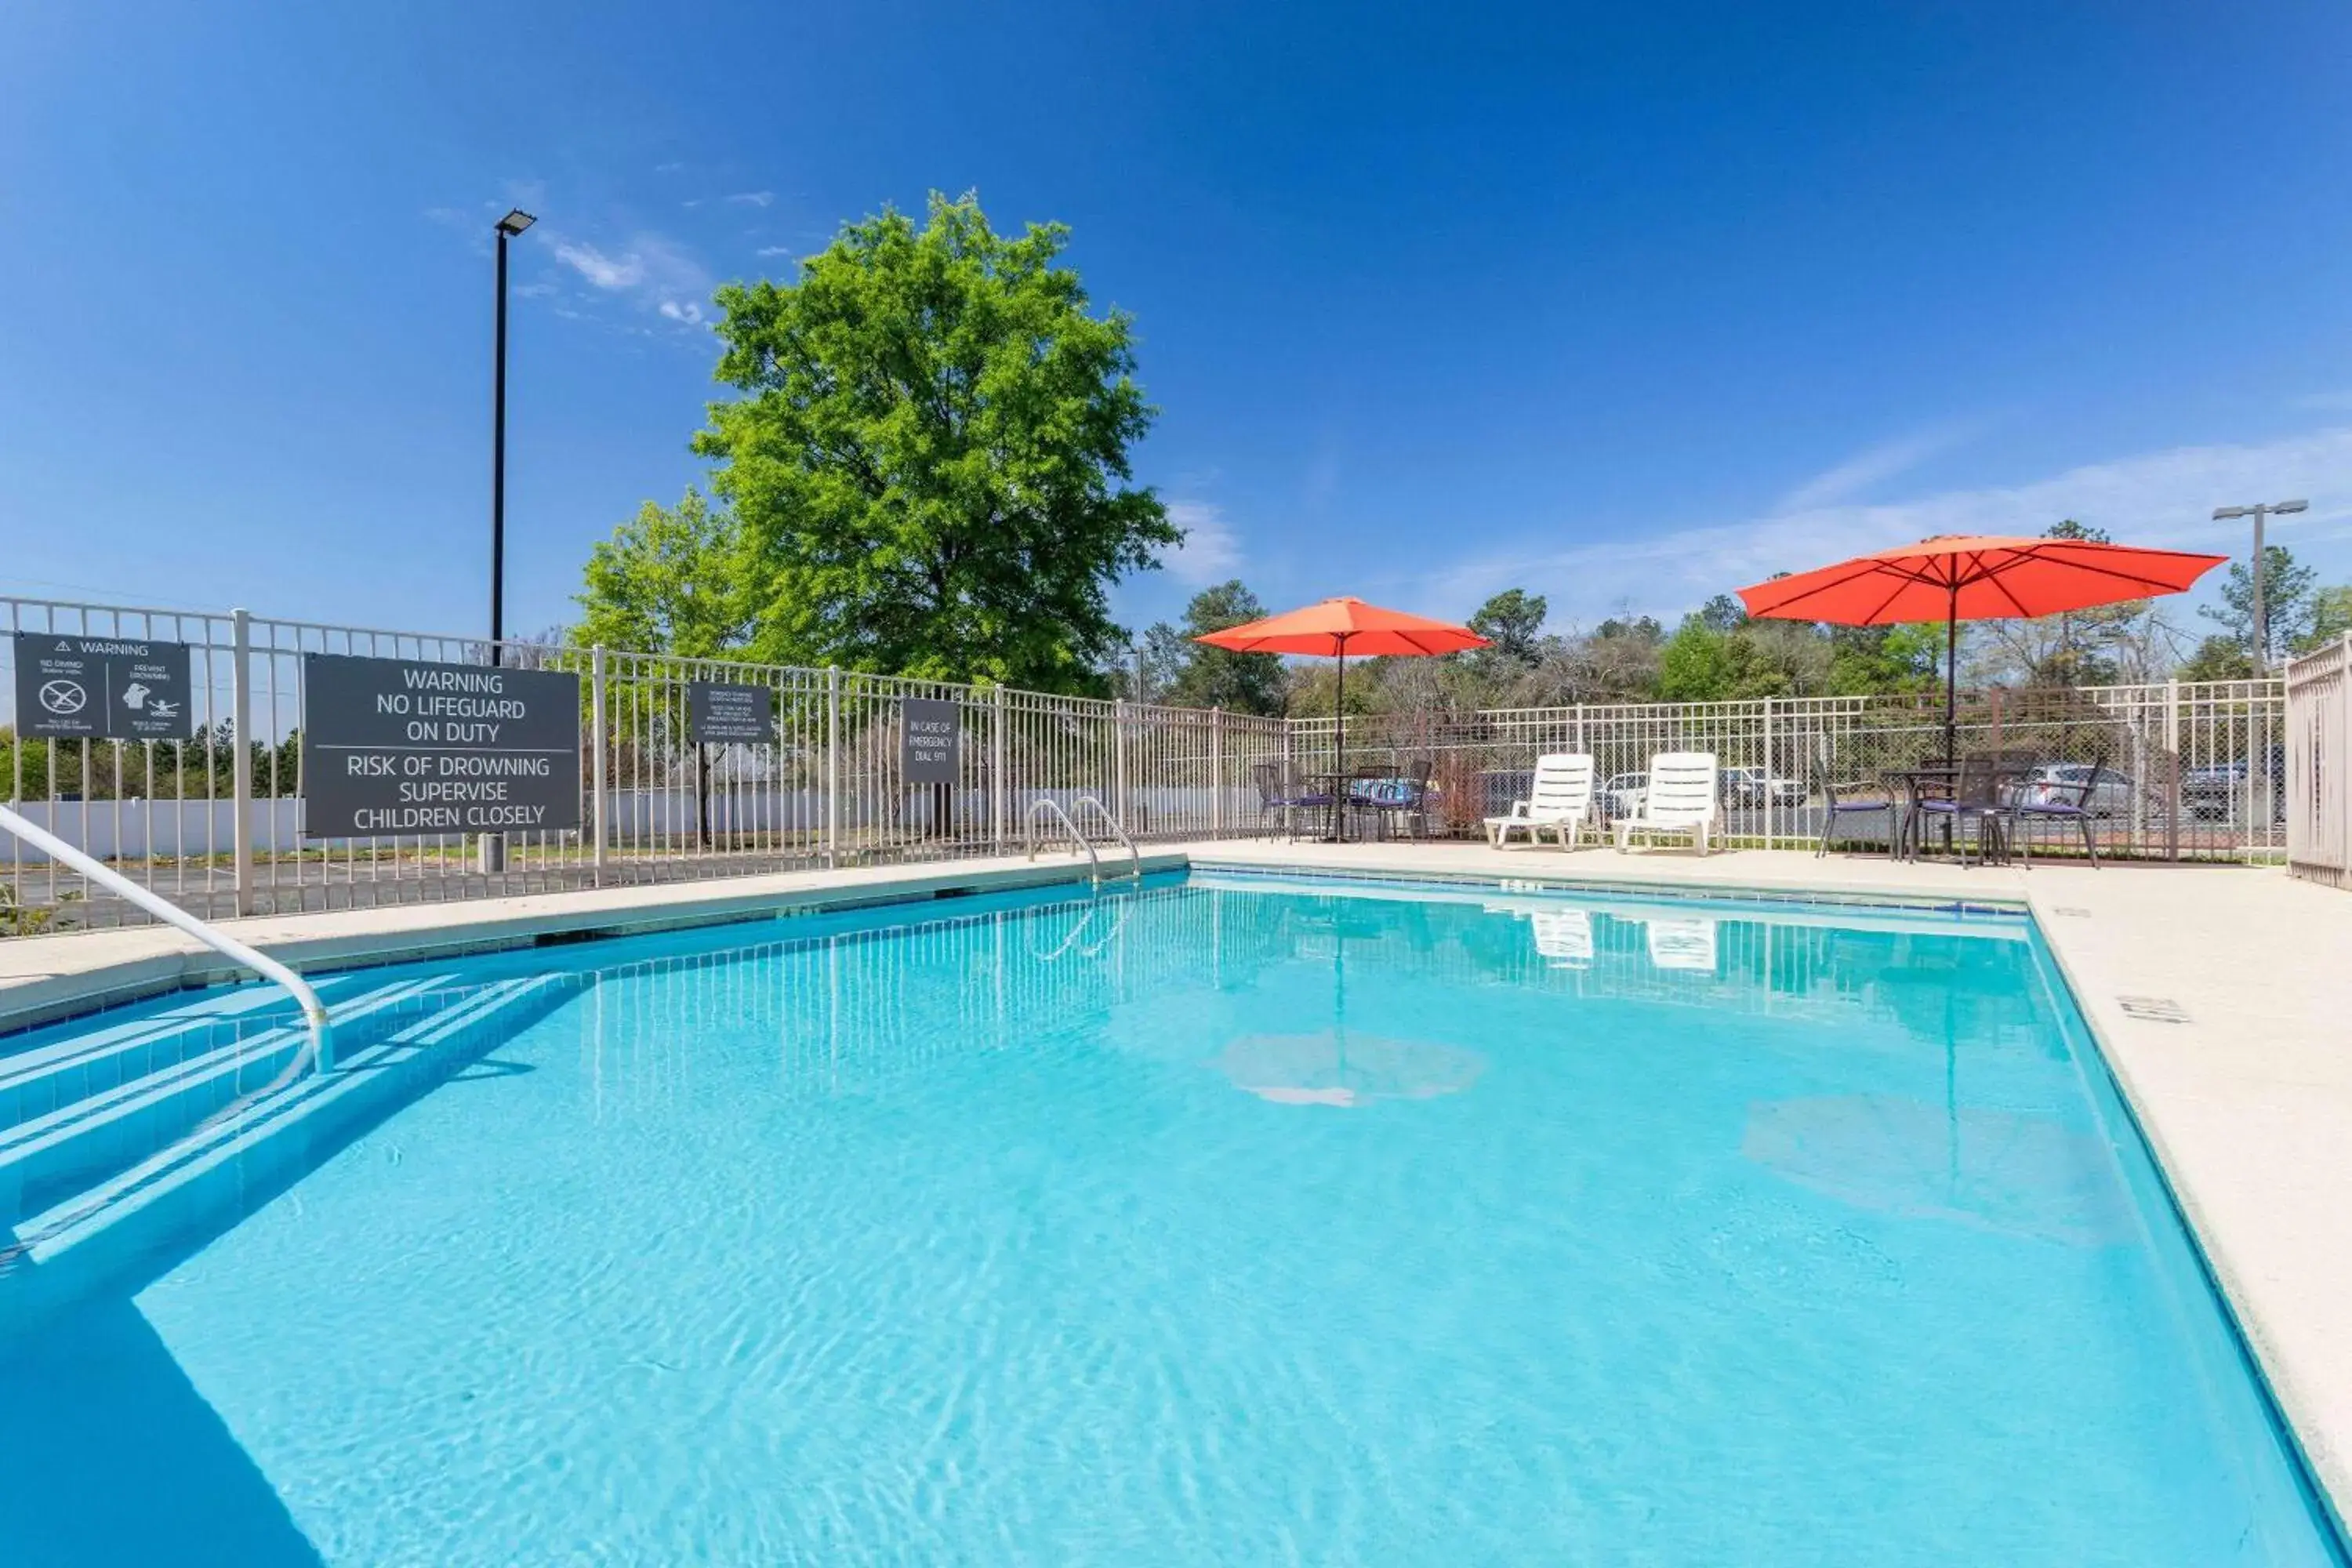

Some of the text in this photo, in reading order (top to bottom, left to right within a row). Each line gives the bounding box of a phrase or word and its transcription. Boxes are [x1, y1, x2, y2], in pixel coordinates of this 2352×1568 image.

[79, 641, 150, 657] WARNING
[404, 669, 503, 694] WARNING
[377, 695, 525, 719] NO LIFEGUARD
[407, 721, 500, 742] ON DUTY
[910, 721, 951, 732] IN CASE OF
[909, 736, 953, 747] EMERGENCY
[347, 756, 550, 776] RISK OF DROWNING
[915, 751, 946, 762] DIAL 911
[399, 782, 507, 802] SUPERVISE
[354, 805, 545, 829] CHILDREN CLOSELY
